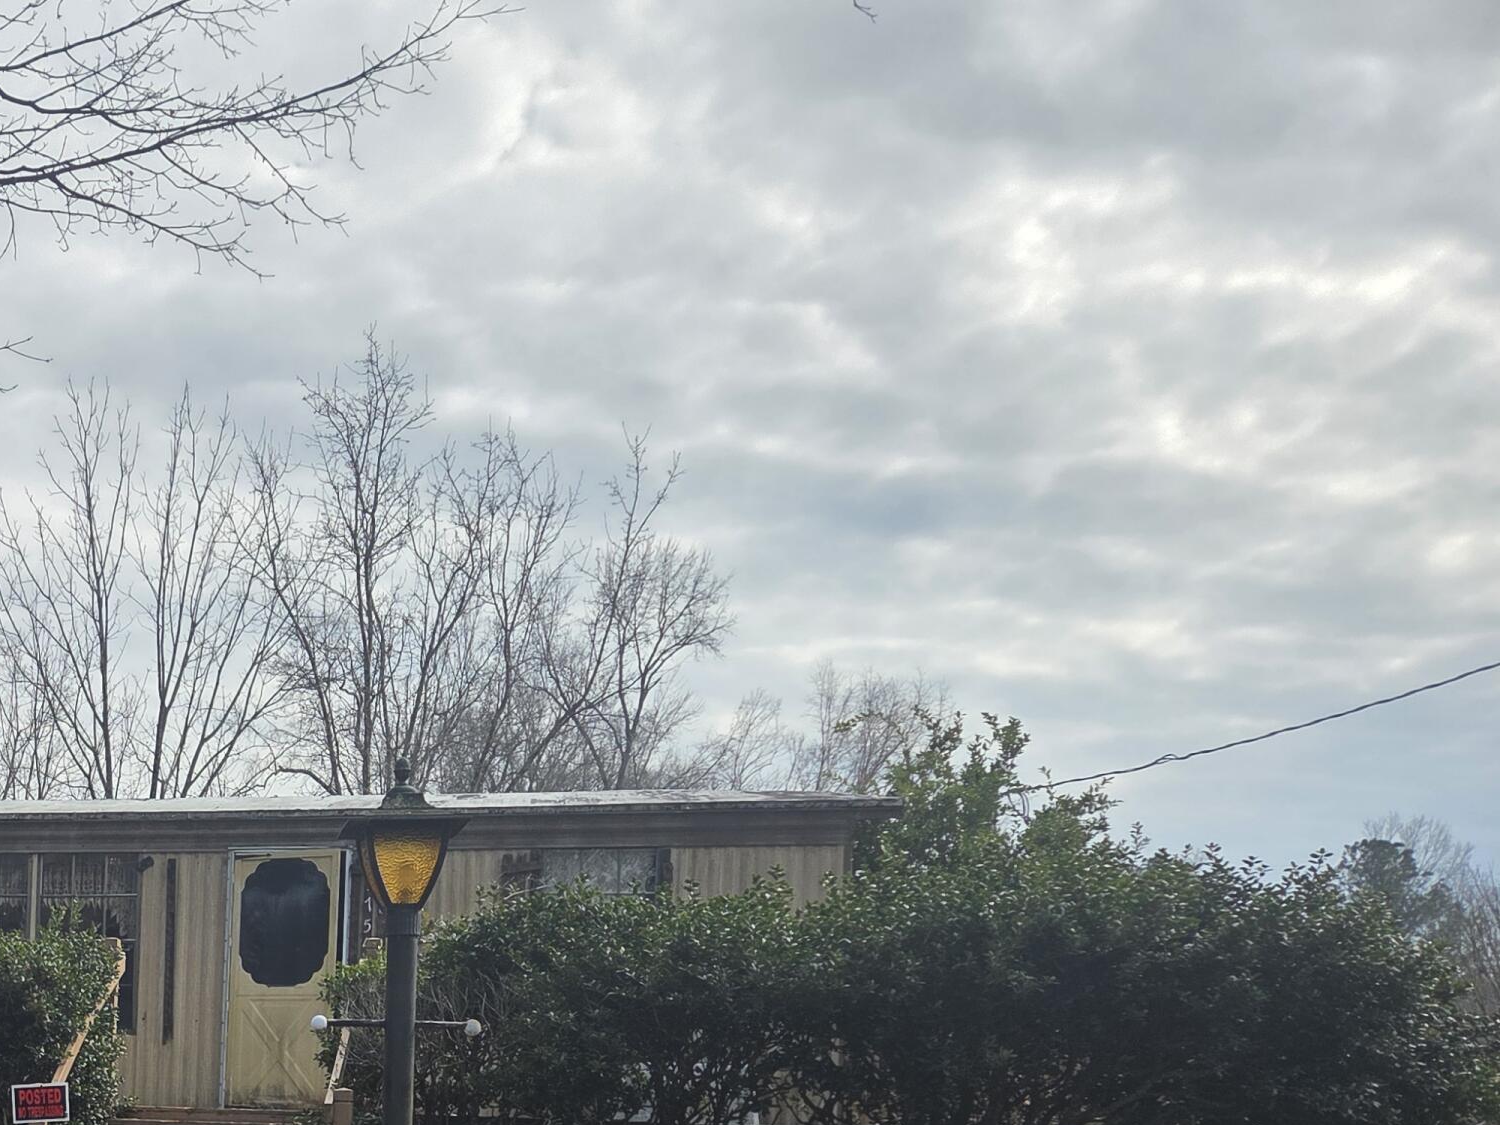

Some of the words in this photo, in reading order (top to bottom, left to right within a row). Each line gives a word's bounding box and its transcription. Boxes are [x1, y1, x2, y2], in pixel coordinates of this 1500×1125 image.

[19, 1088, 61, 1105] POSTED
[18, 1107, 27, 1119] NO
[28, 1105, 64, 1118] TRESPASSING
